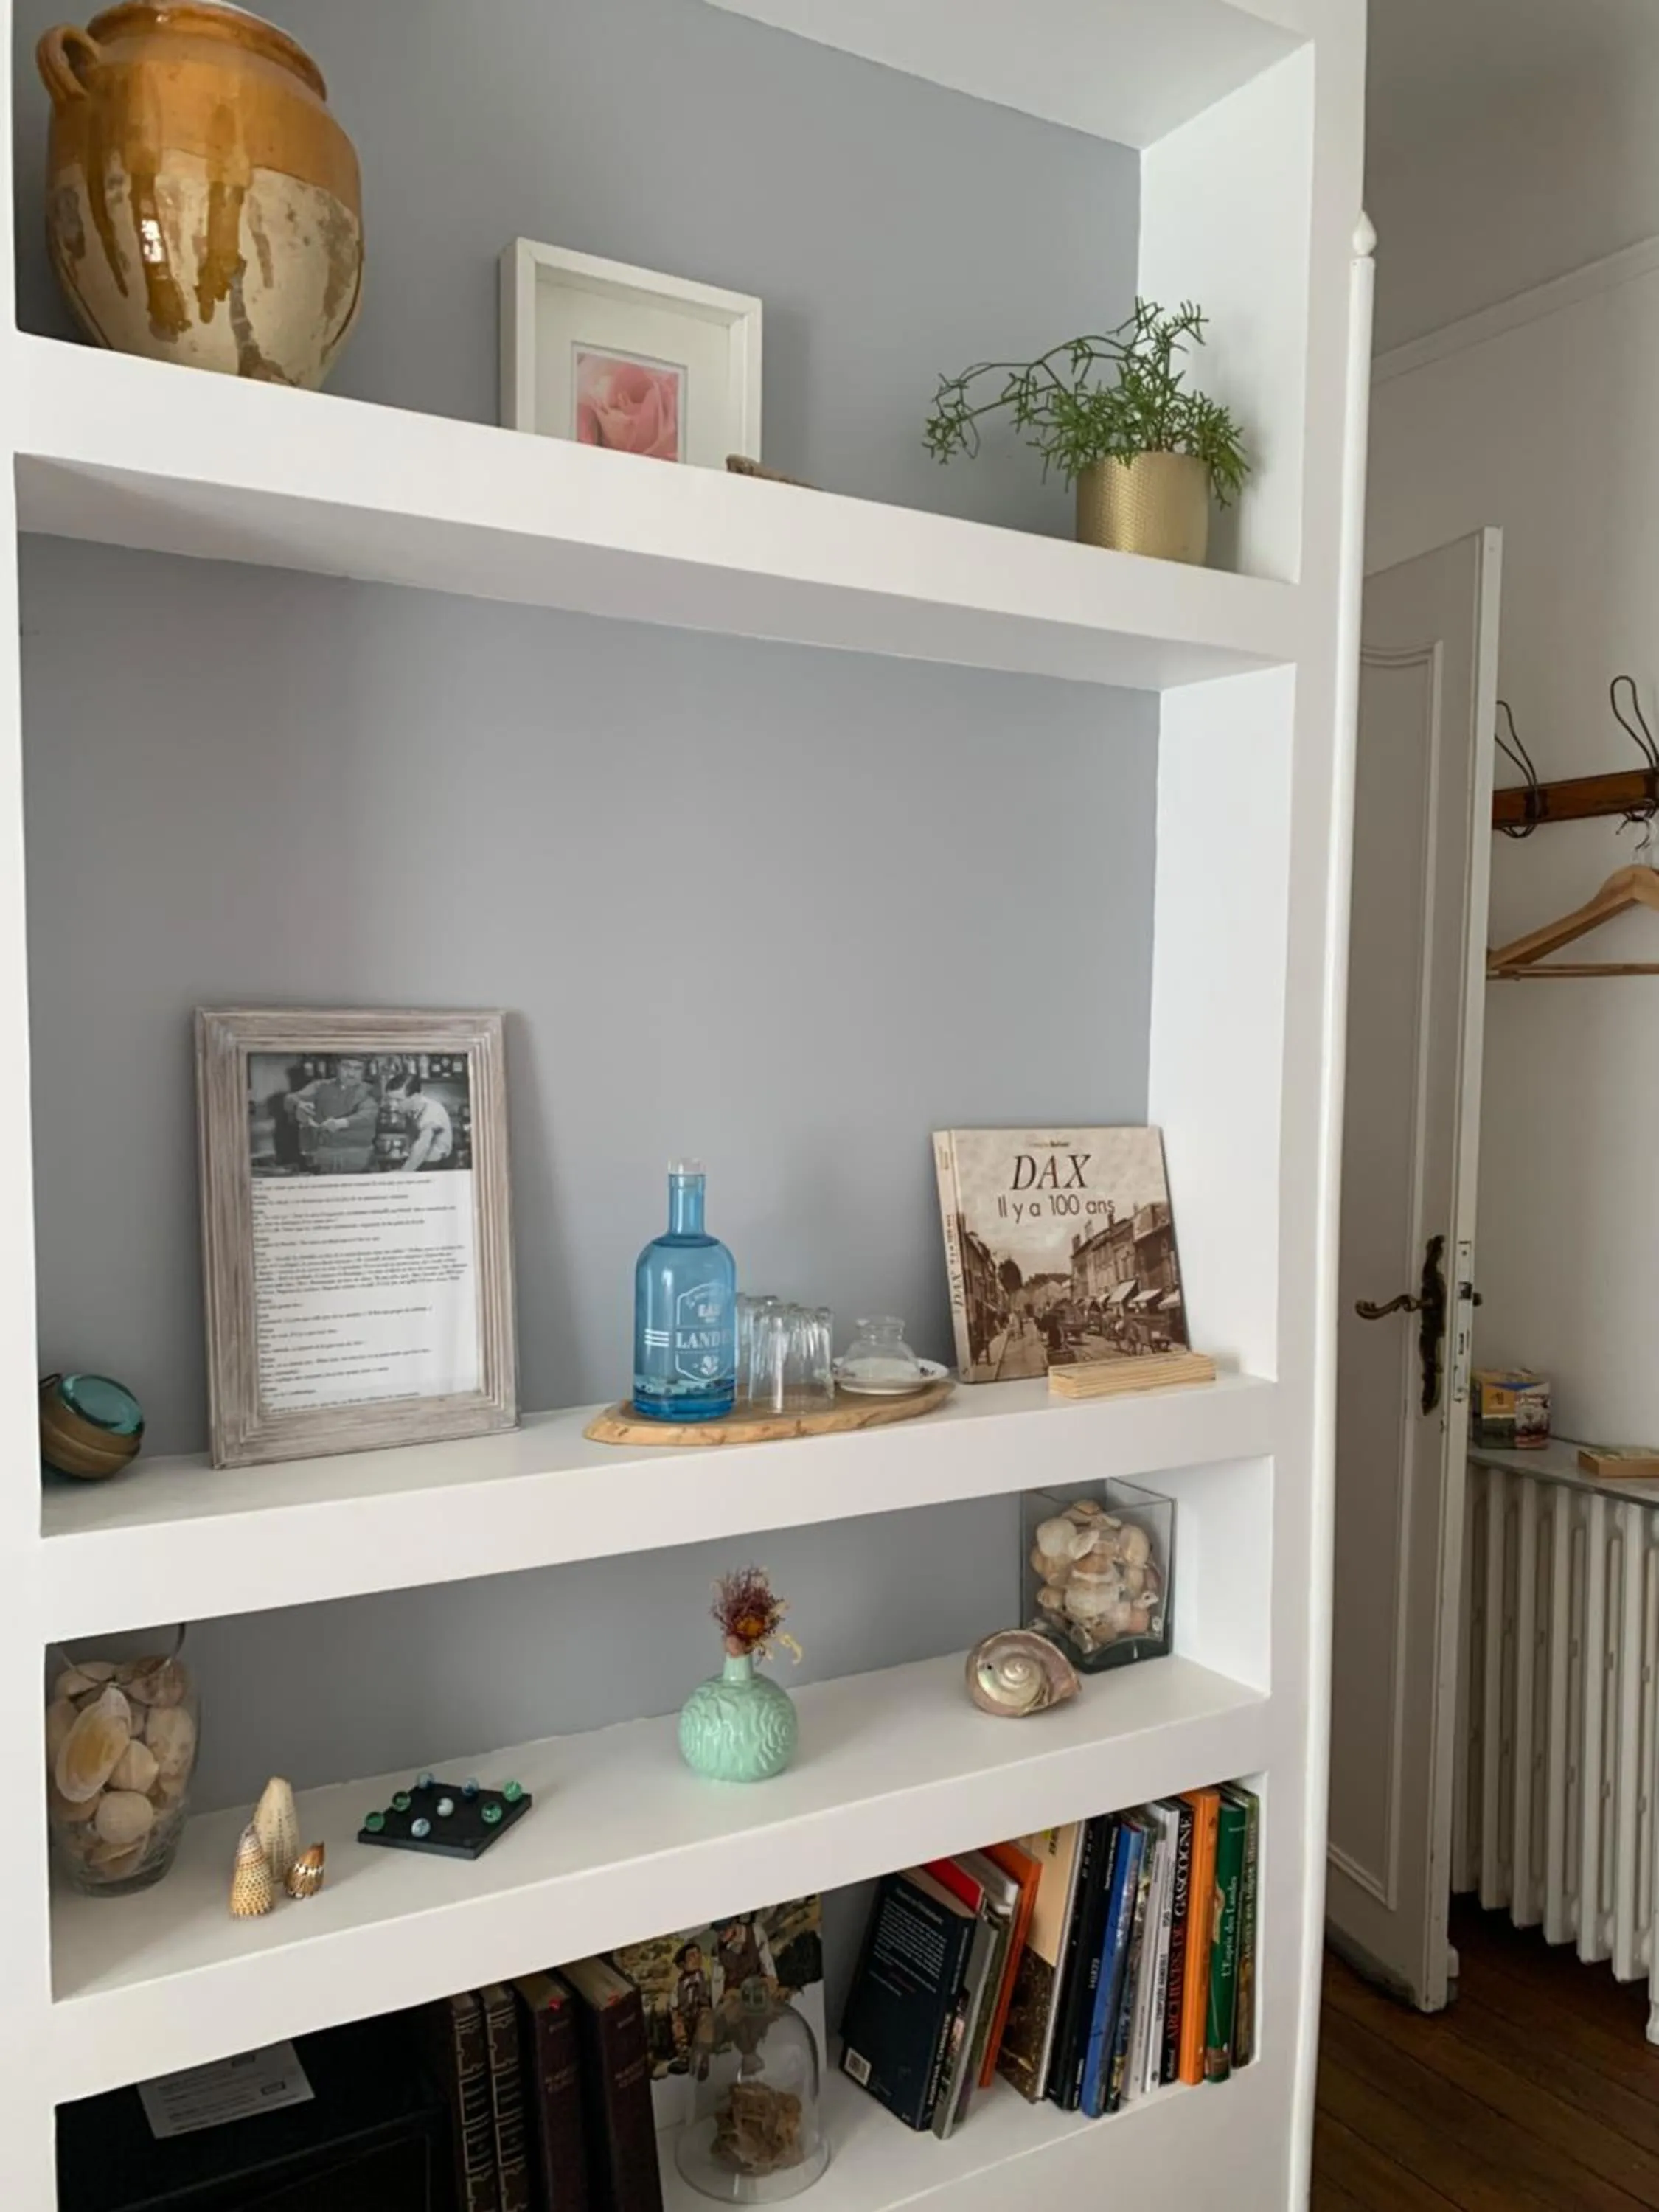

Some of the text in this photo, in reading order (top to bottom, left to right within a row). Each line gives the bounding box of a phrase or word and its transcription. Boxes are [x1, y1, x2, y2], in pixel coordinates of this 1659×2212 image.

[1010, 1153, 1091, 1191] DAX
[998, 1193, 1115, 1224] Il y a 100 ans
[1174, 1815, 1192, 1917] GASCOGNE
[1172, 1925, 1186, 1947] DE
[1220, 1876, 1238, 1978] L'Esprit des Landes
[1166, 1951, 1183, 2041] ARCHIVES
[936, 2012, 953, 2062] CHRISTIE
